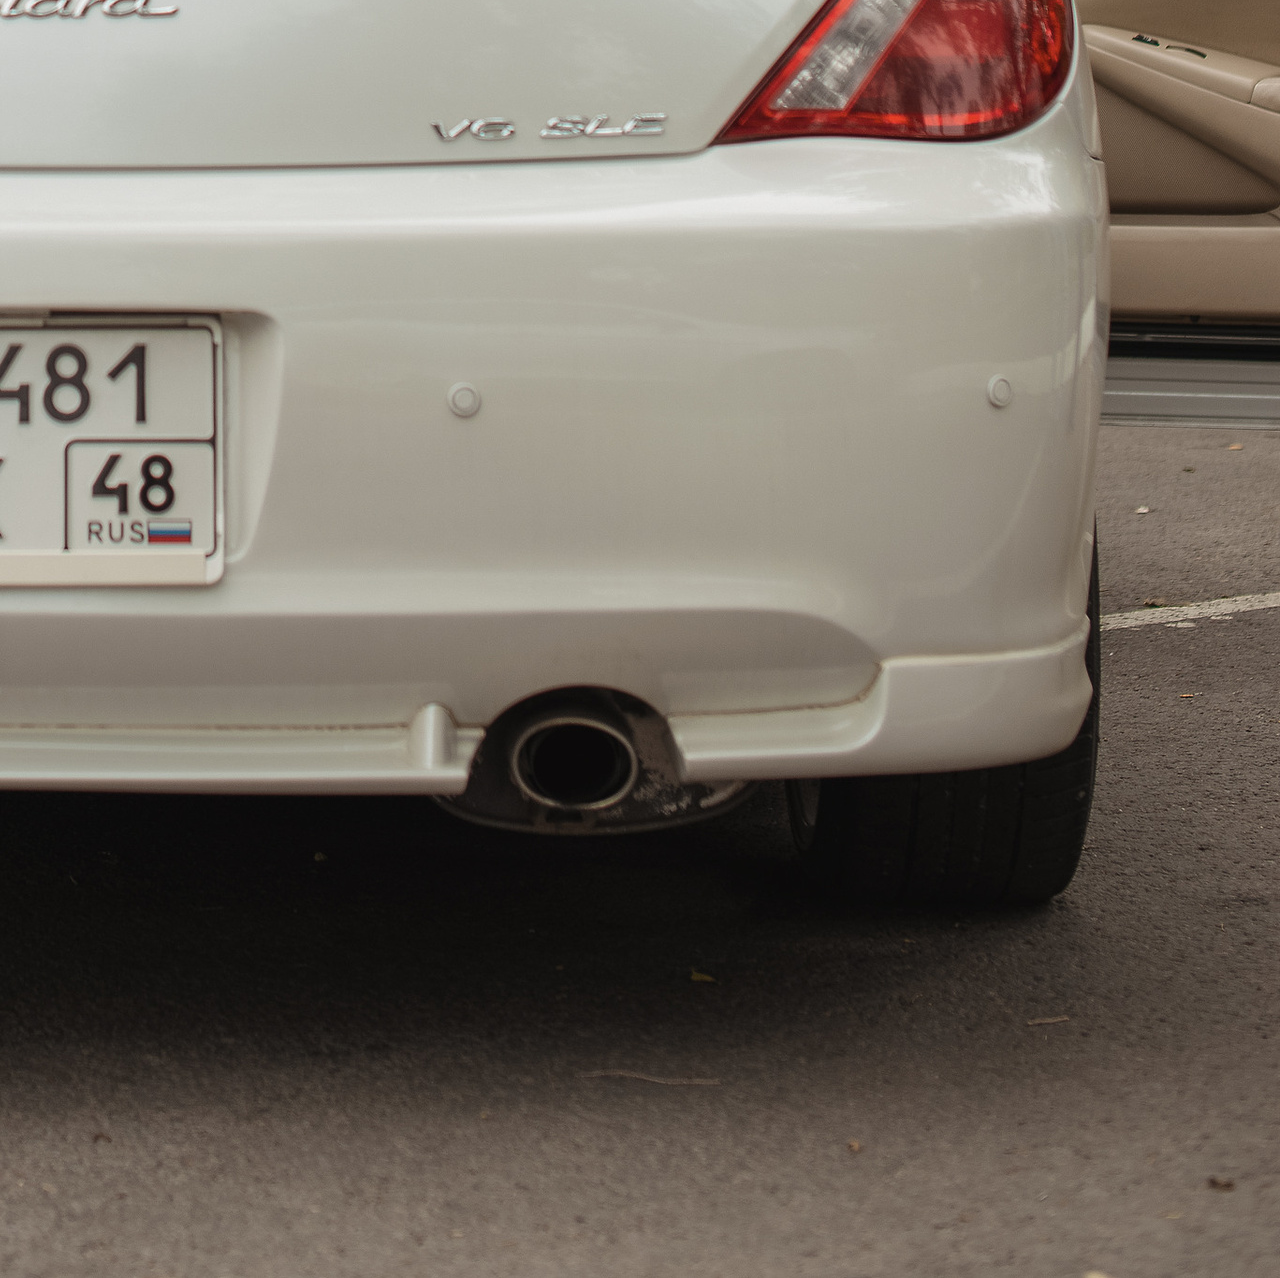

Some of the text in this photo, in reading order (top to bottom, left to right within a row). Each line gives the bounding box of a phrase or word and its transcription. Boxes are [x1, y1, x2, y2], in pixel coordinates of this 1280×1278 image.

[430, 112, 668, 142] V6 SLE
[92, 454, 175, 515] 48
[88, 521, 145, 544] RUS
